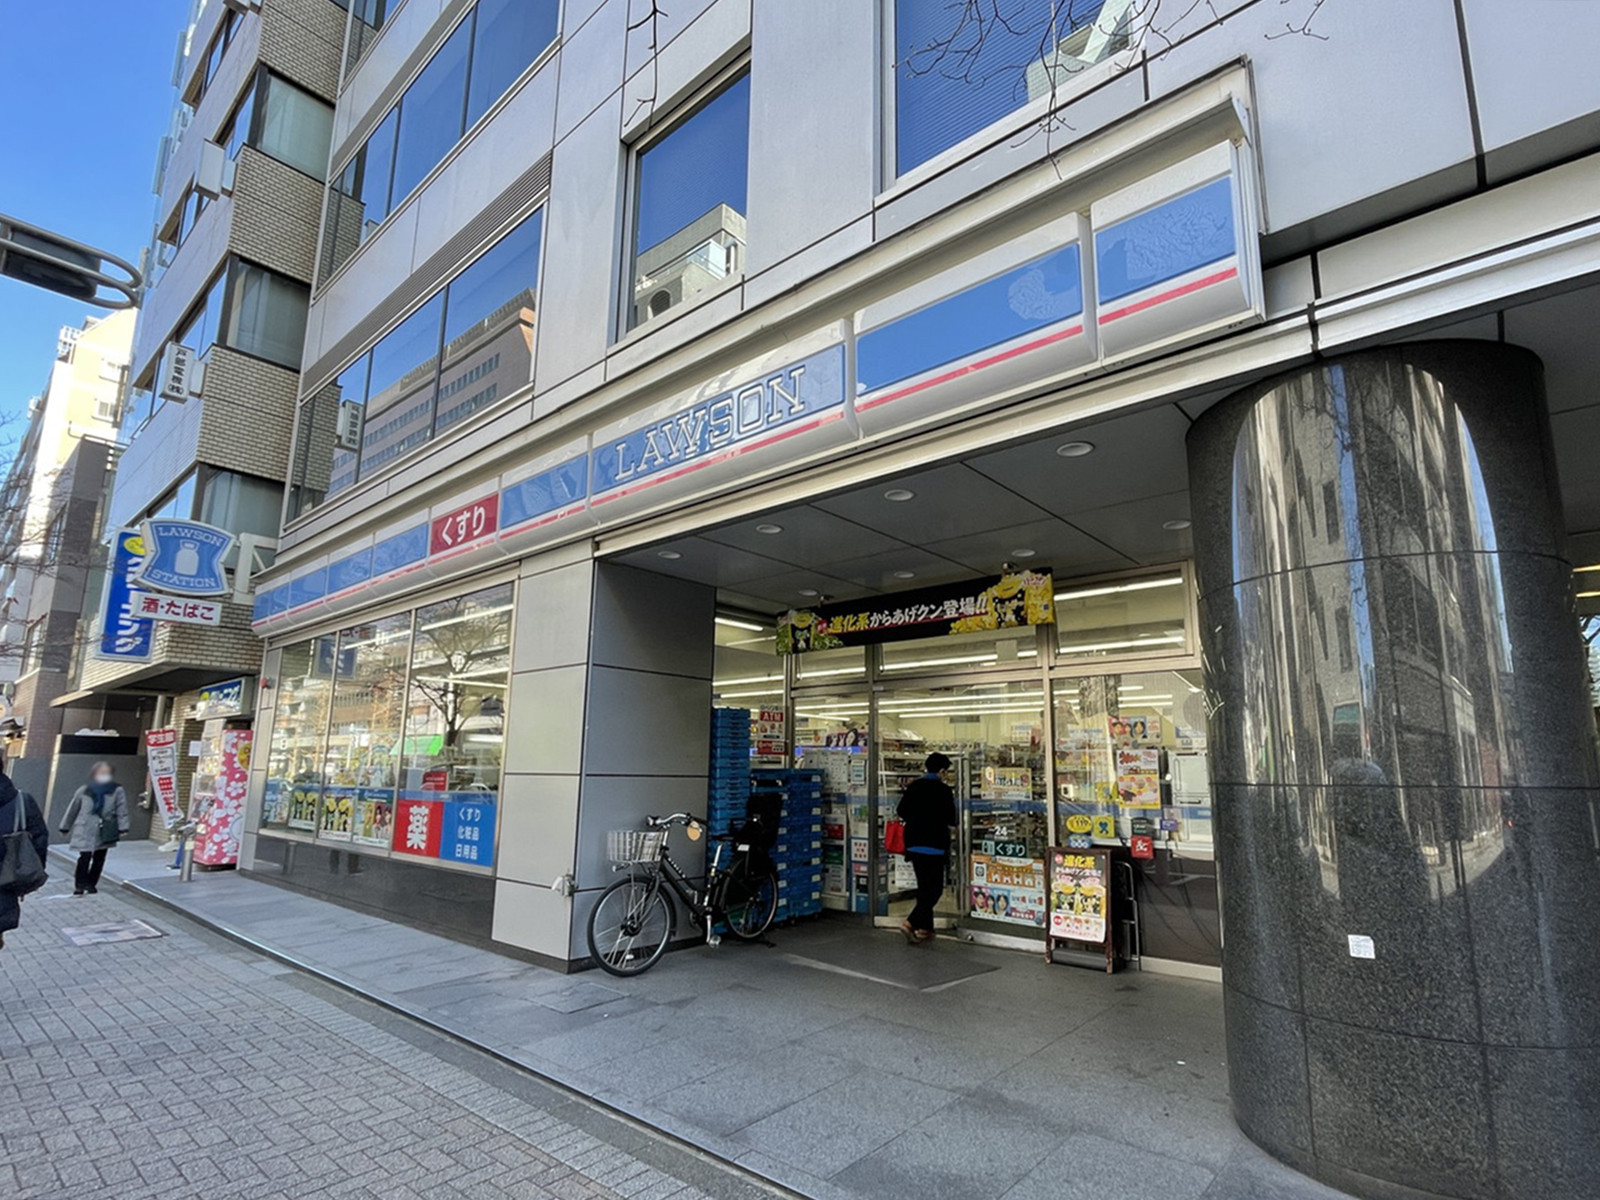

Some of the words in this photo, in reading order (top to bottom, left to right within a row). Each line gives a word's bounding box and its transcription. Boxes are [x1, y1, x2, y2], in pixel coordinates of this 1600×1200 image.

[614, 364, 806, 482] LAWSON
[441, 505, 486, 547] くすり
[158, 527, 224, 547] LAWSON
[151, 569, 217, 588] STATION
[142, 597, 215, 621] 酒・たばこ
[763, 711, 782, 721] ATM
[459, 807, 481, 822] くすり
[406, 805, 429, 850] 薬
[458, 825, 480, 841] 化粧品
[994, 825, 1008, 836] 24
[455, 843, 478, 860] 日用品
[996, 842, 1026, 856] くすり
